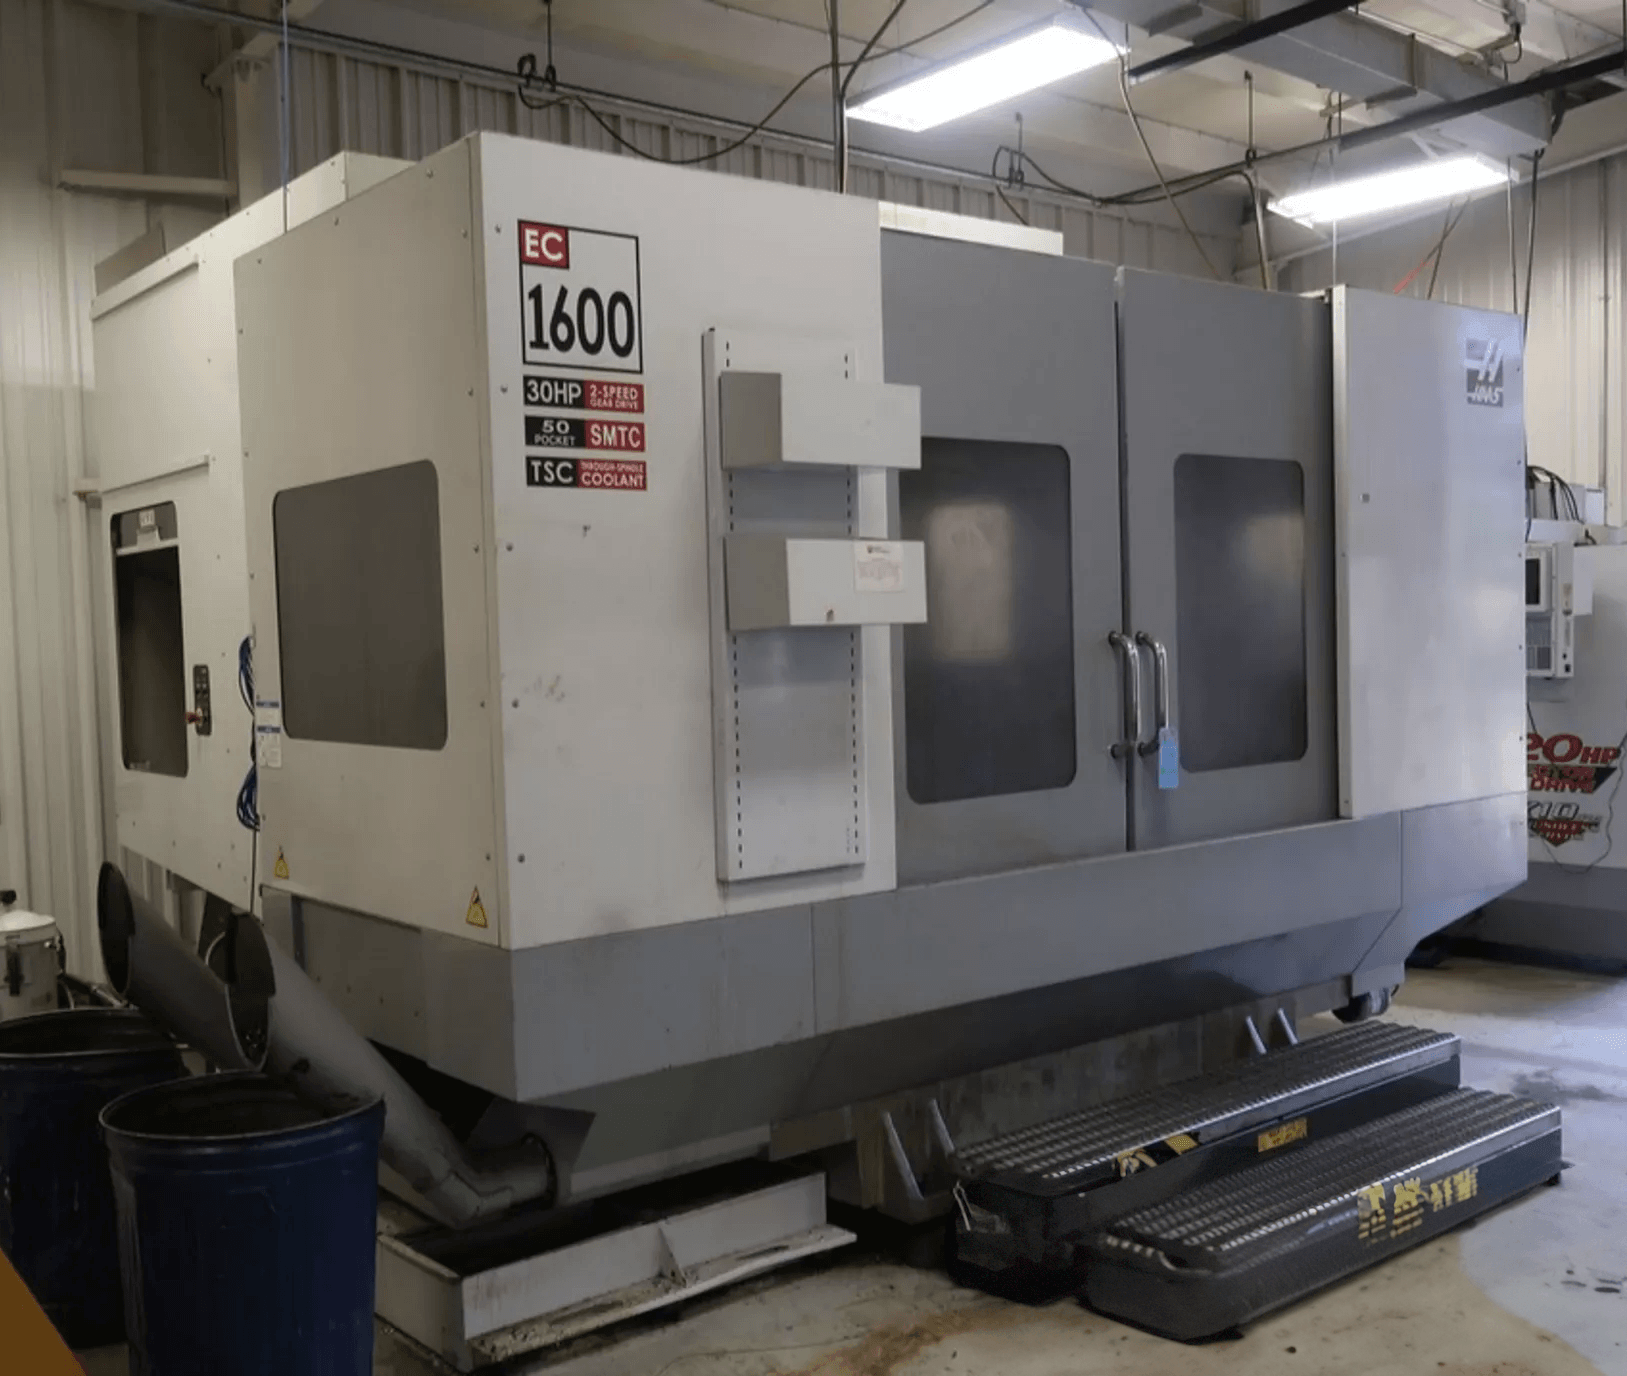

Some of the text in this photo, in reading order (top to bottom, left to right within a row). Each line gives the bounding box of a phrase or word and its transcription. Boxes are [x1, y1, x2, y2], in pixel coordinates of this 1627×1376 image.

[524, 228, 564, 262] EC
[528, 283, 635, 358] 1600
[527, 379, 581, 405] 30HP
[590, 384, 638, 400] 2-SPEED
[615, 400, 638, 410] DRIVE
[542, 419, 570, 434] 50
[590, 423, 640, 448] SMTC
[534, 433, 575, 446] POCKET
[530, 460, 573, 484] TSC
[581, 472, 643, 487] COOLANT
